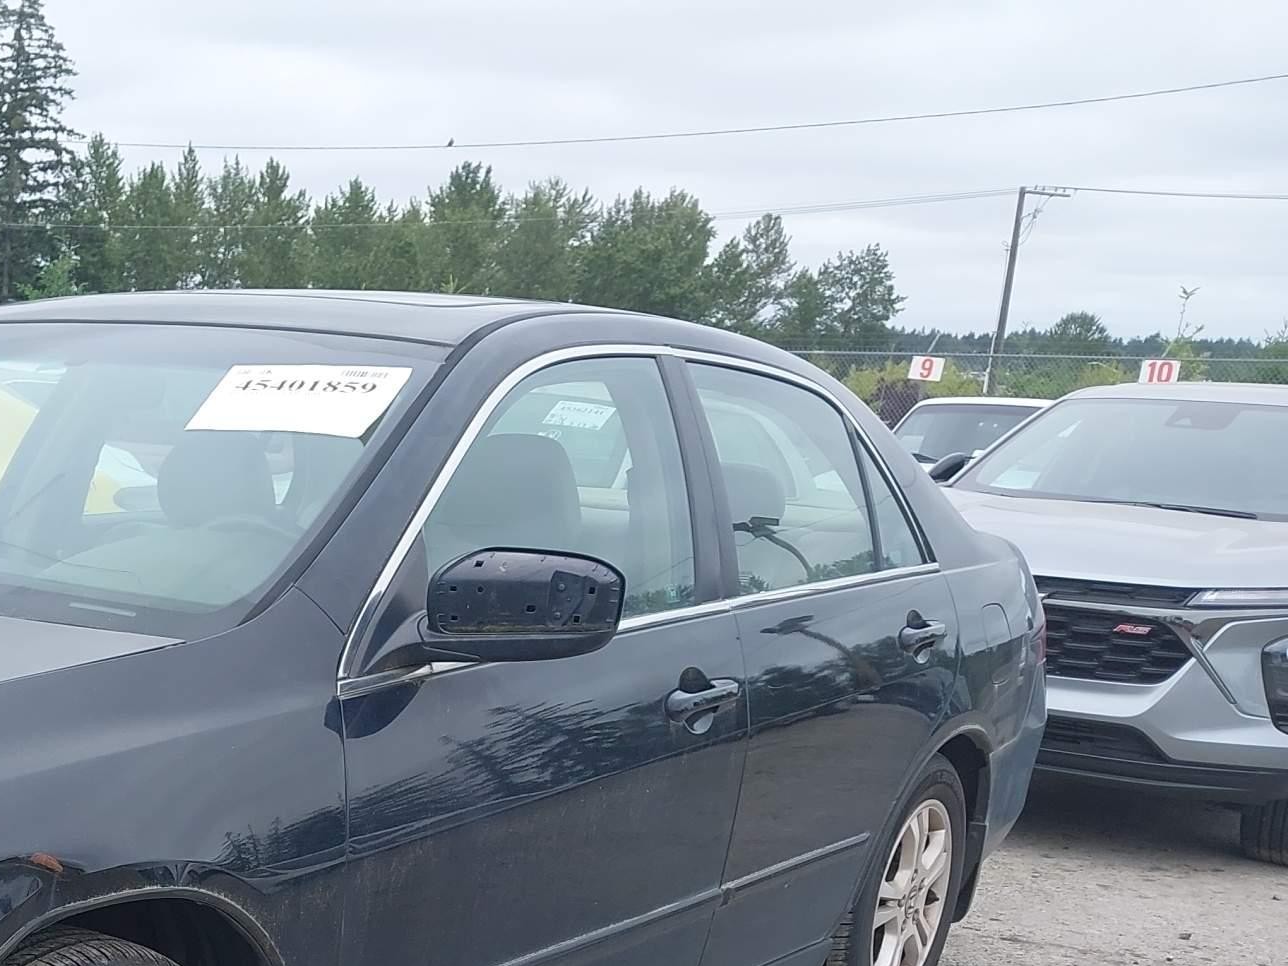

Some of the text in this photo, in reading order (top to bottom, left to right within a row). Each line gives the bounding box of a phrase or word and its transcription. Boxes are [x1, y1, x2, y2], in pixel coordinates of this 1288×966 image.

[919, 358, 934, 379] 9
[1147, 361, 1173, 384] 10
[235, 378, 379, 394] 45401859
